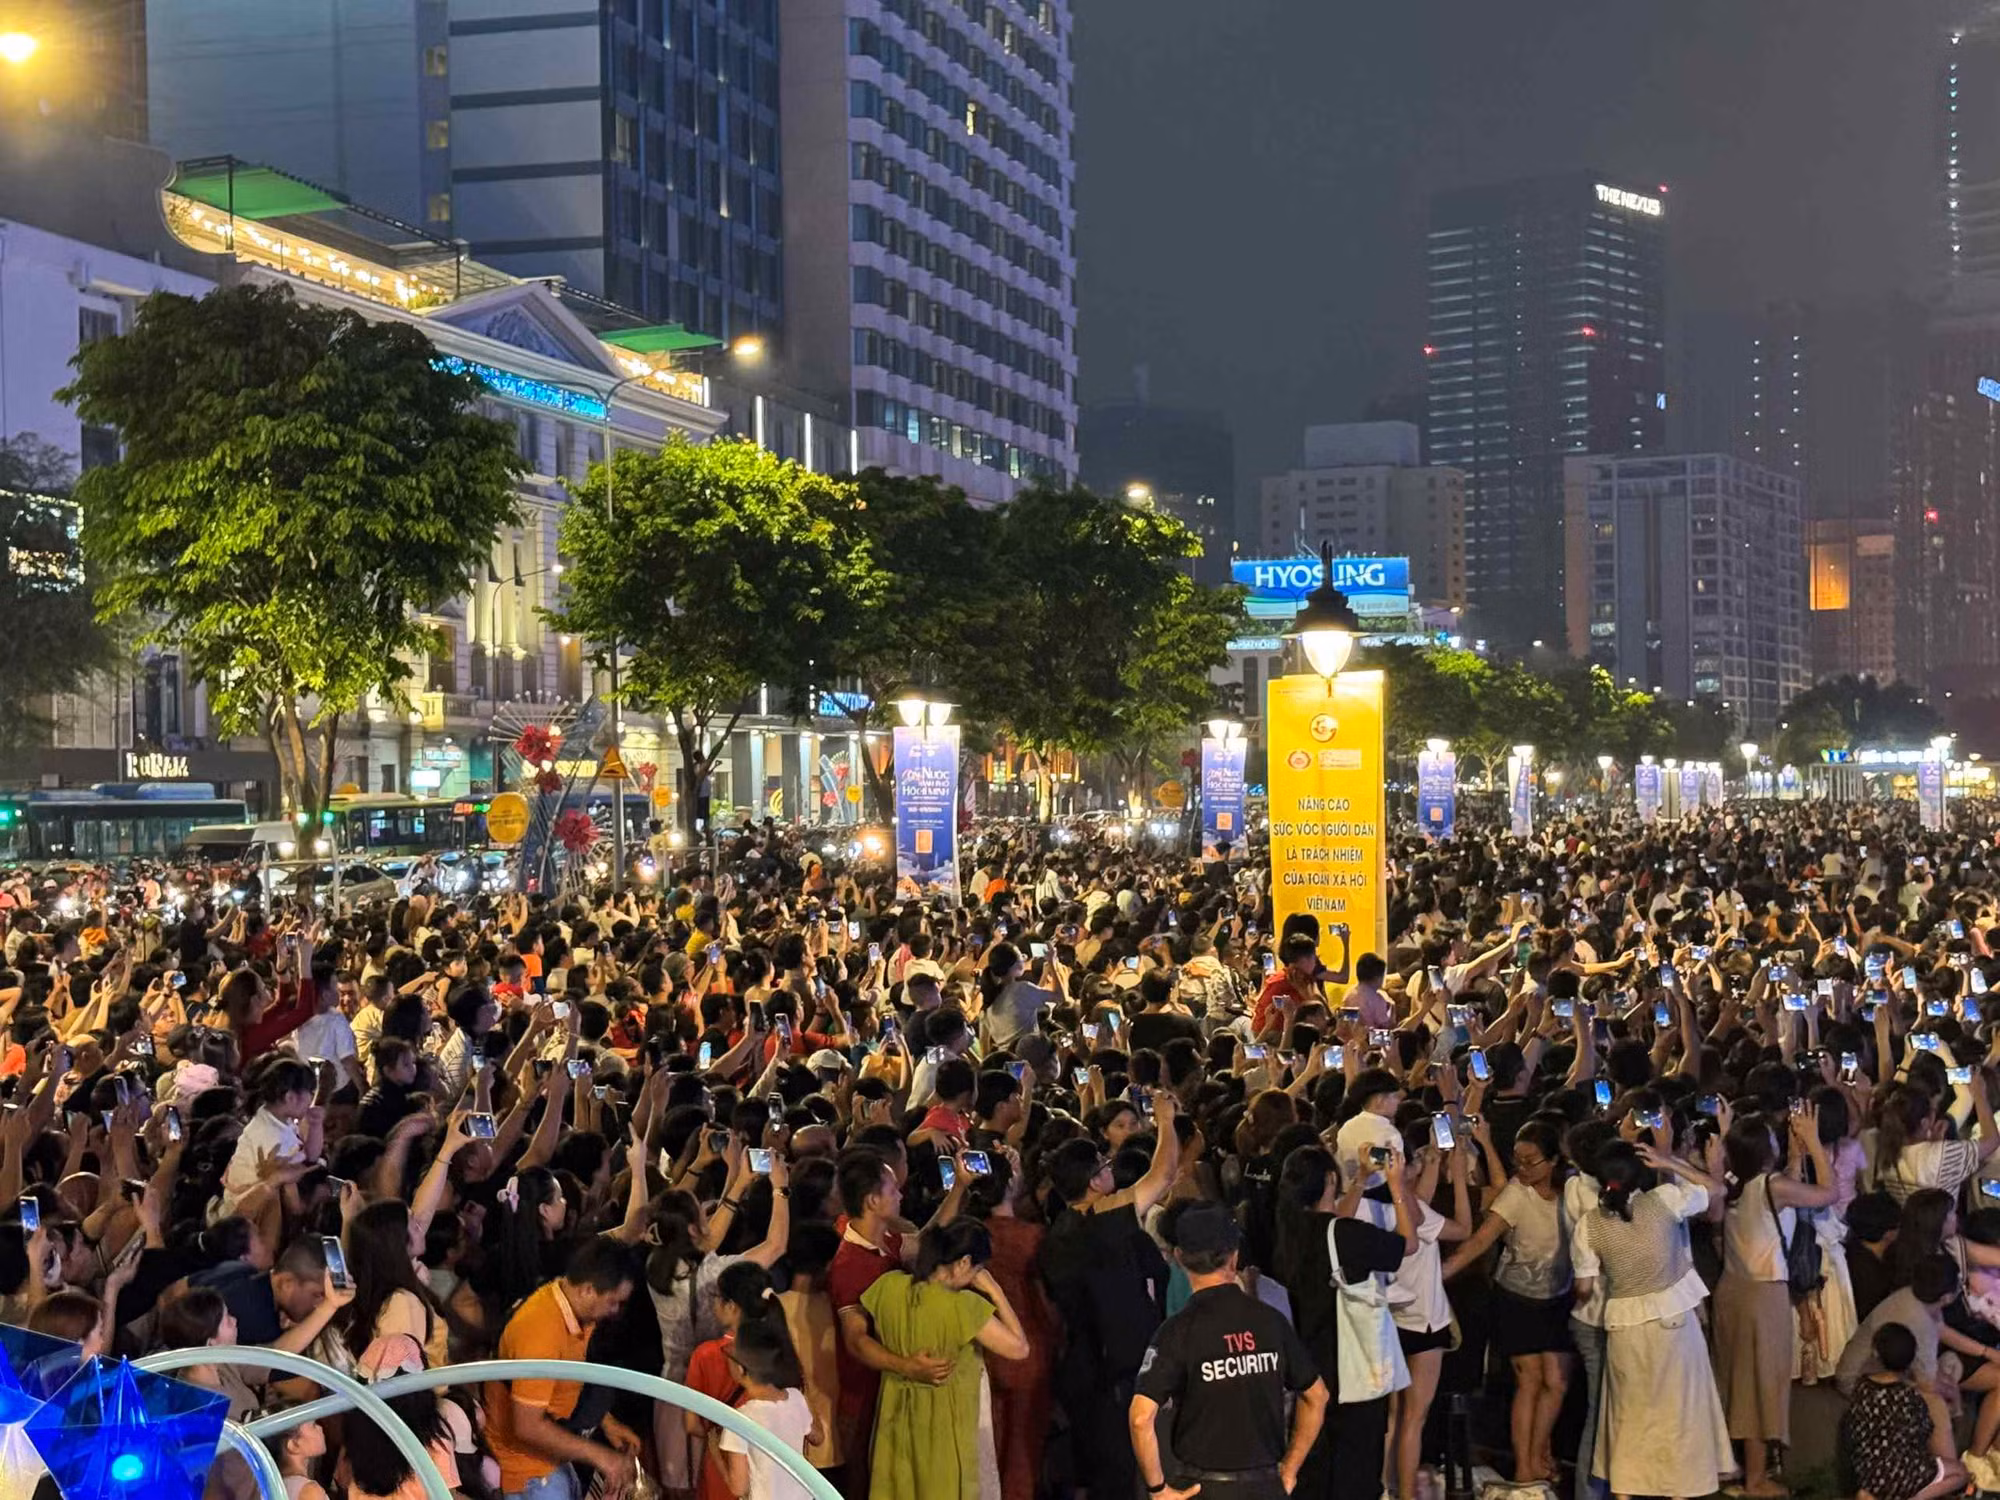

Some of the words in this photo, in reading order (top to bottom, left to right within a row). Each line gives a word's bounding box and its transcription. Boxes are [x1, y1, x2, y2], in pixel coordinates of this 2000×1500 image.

[1595, 184, 1620, 205] THE
[1620, 190, 1661, 216] NEXUS
[1298, 795, 1325, 811] NÂNG
[1328, 799, 1350, 811] CAO
[1273, 820, 1293, 836] SỨC
[1296, 820, 1319, 836] VÓC
[1354, 821, 1374, 836] DÂN
[1286, 845, 1297, 860] LÀ
[1301, 845, 1329, 860] TRÁCH
[1333, 845, 1363, 865] NHIỆM
[1283, 869, 1305, 885] CỦA
[1333, 871, 1347, 886] XÃ
[1350, 870, 1367, 890] HỘI
[1223, 1330, 1256, 1353] TVS
[1201, 1352, 1278, 1382] SECURITY
